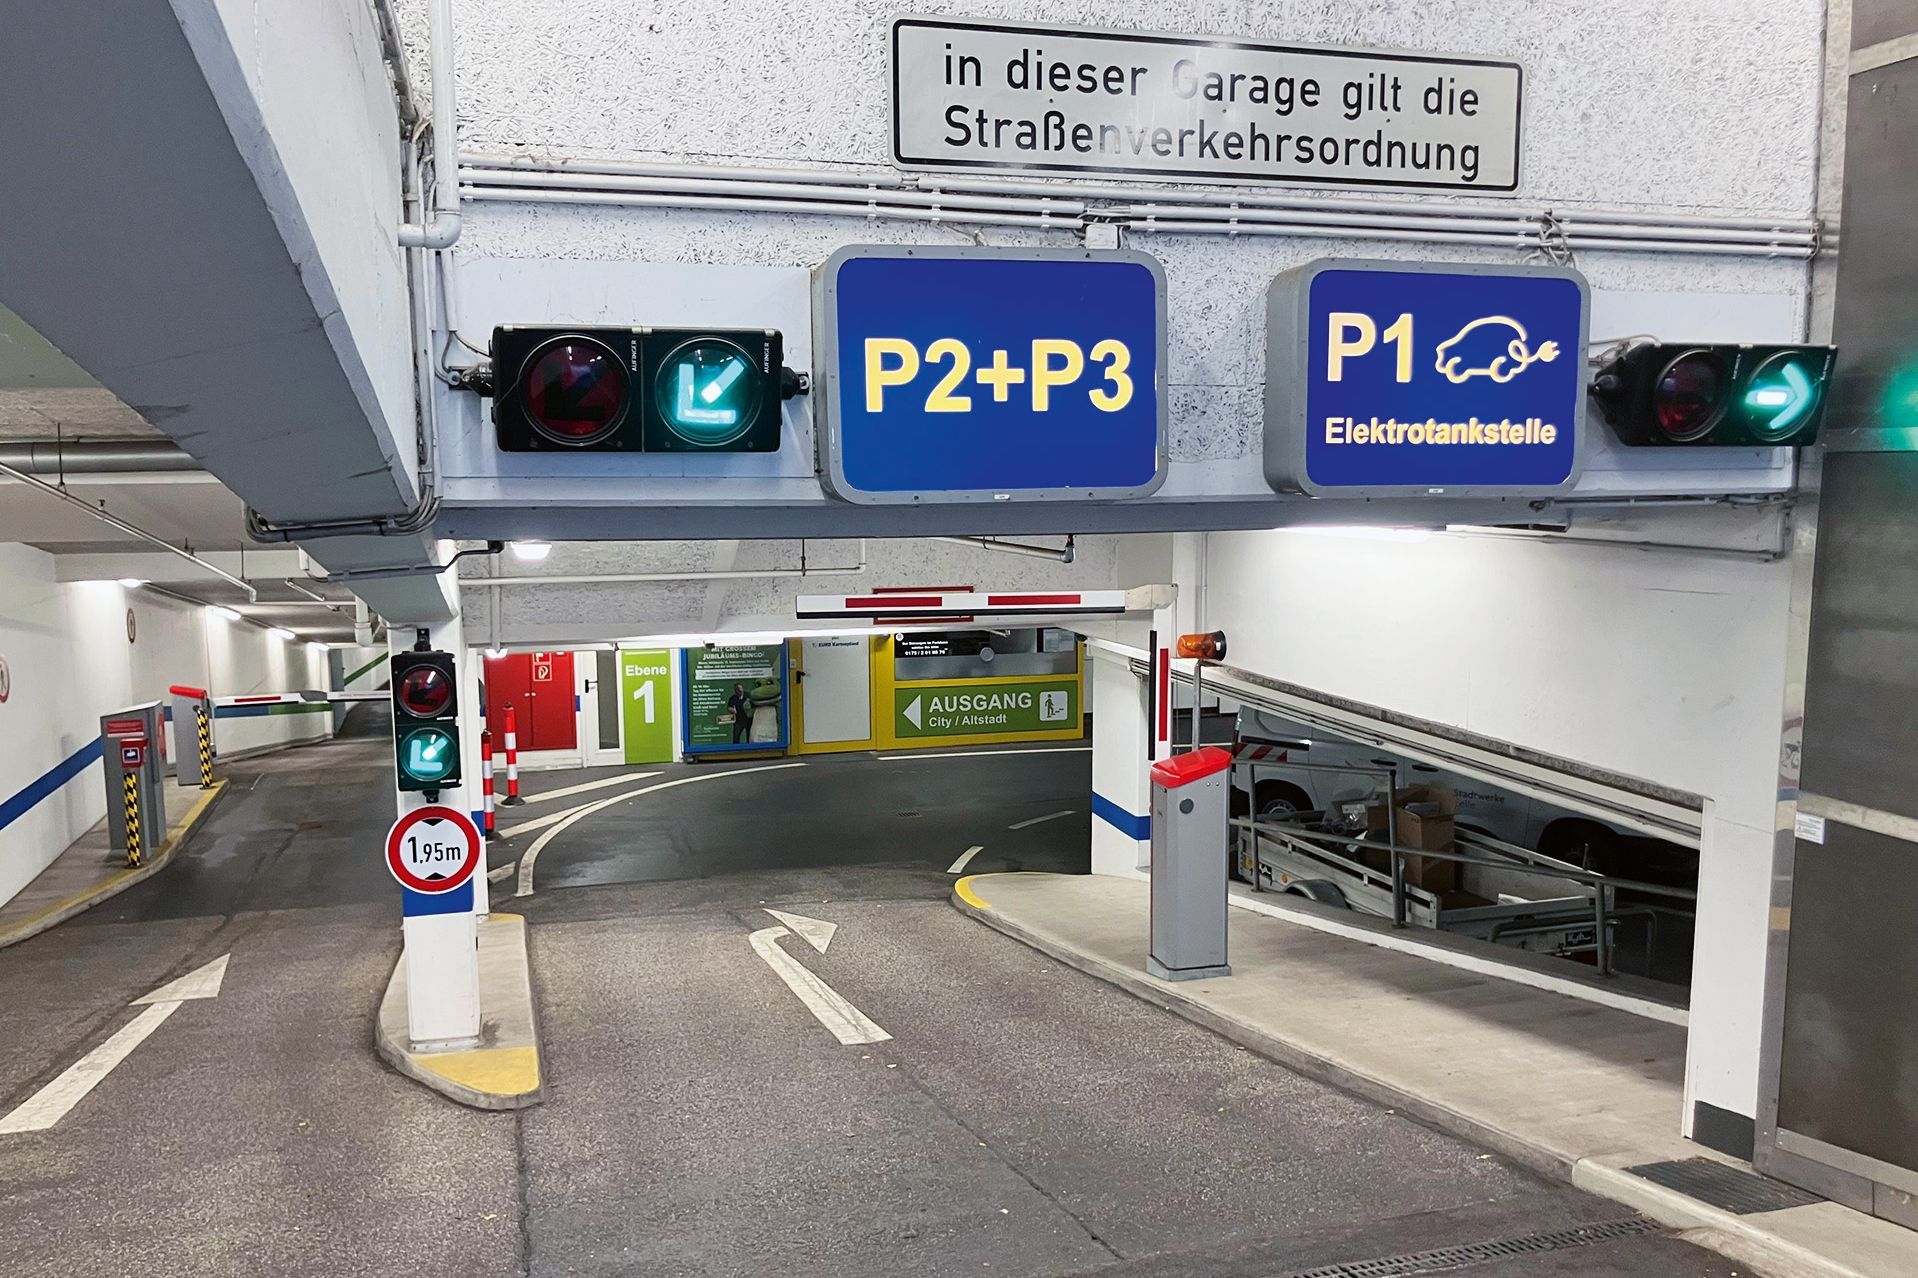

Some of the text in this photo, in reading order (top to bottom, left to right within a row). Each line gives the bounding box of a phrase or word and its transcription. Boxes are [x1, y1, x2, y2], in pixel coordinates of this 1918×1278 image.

[945, 43, 1480, 121] in dieser Garage gilt die
[944, 104, 1480, 183] Straßenverkehrsordnung
[1327, 312, 1413, 383] P1
[864, 337, 1134, 412] P2+P3
[1325, 416, 1557, 445] Elektrotankstelle
[625, 664, 667, 677] Ebene
[633, 680, 655, 724] 1
[929, 692, 1032, 713] AUSGANG
[929, 713, 1007, 729] City / Altstadt
